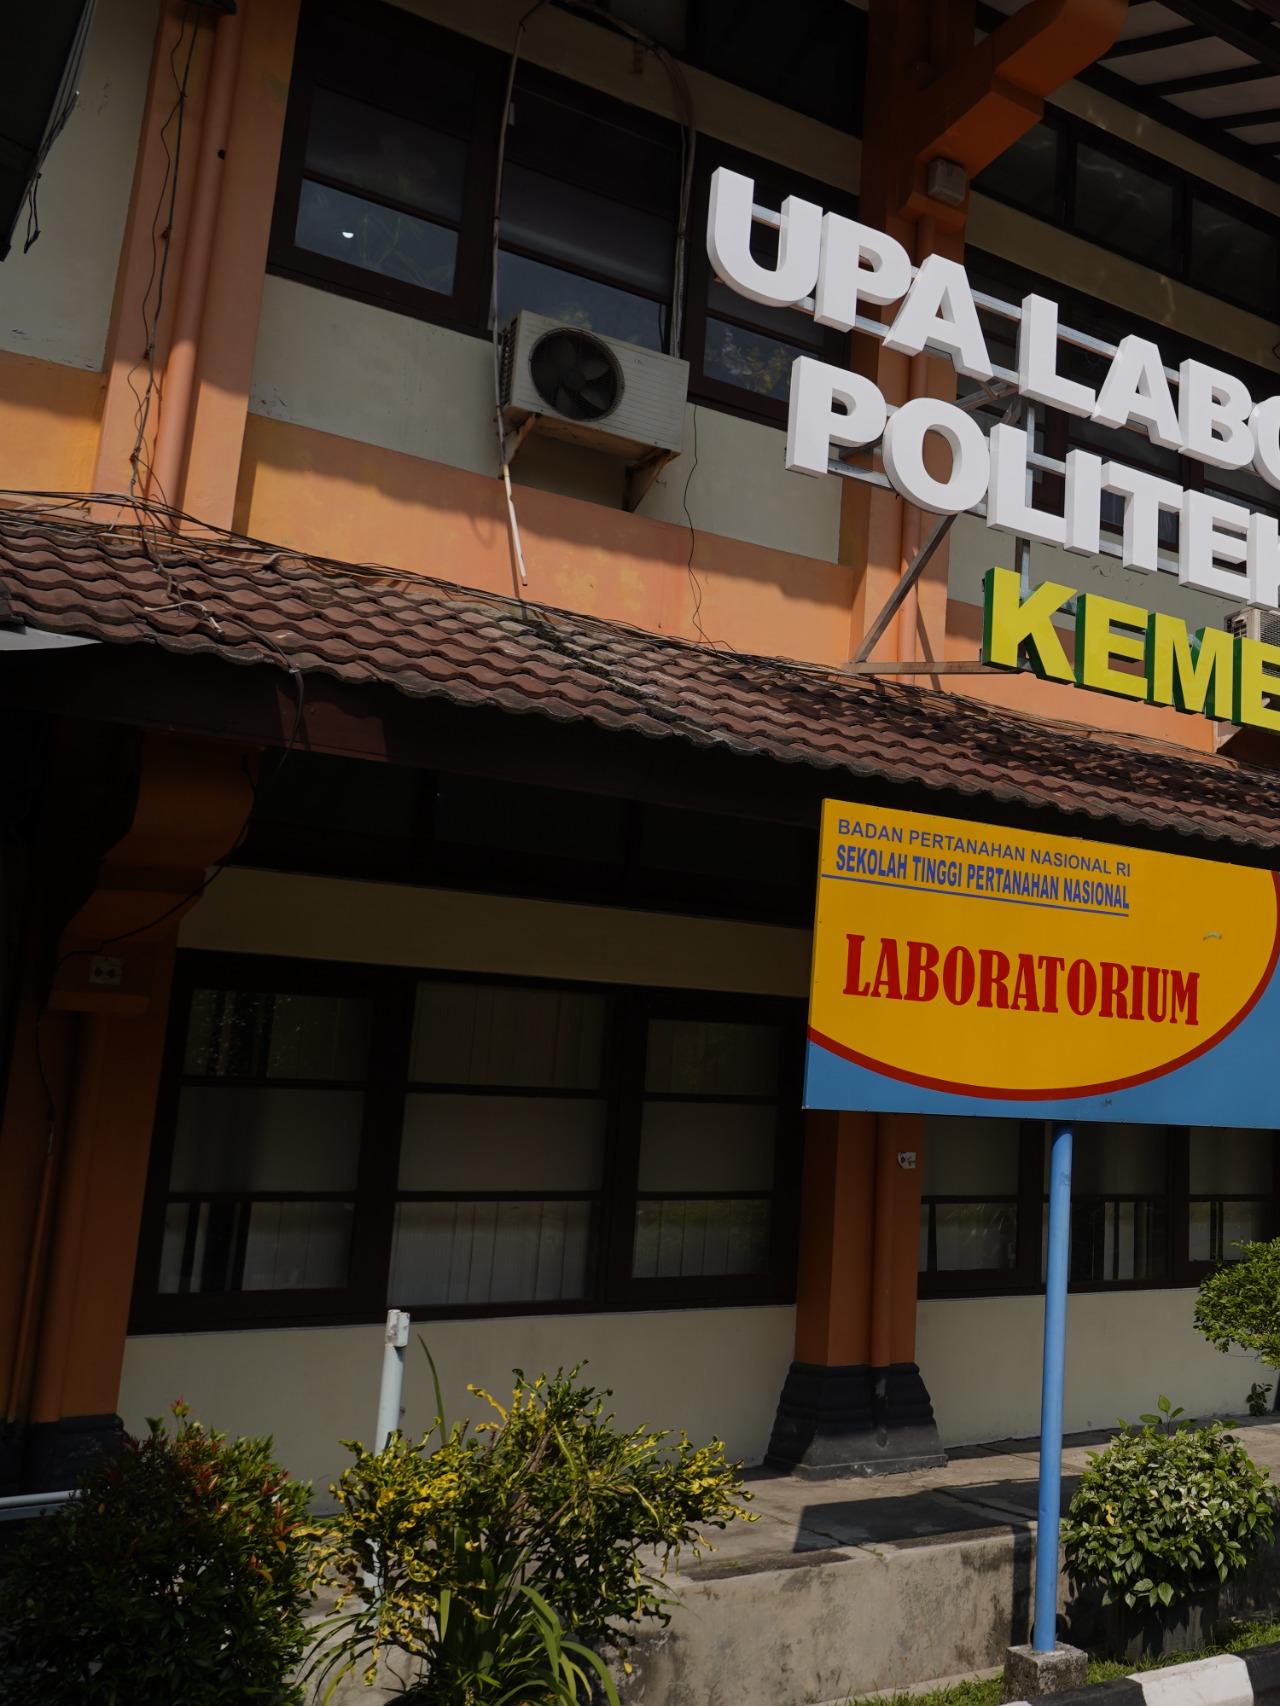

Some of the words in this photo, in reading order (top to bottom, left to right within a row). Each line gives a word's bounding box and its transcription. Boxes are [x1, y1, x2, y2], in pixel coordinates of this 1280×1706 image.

[706, 166, 994, 382] UPA
[835, 844, 907, 880] SEKOLAH
[912, 856, 963, 888] TINGGI
[966, 863, 1060, 901] PERTANAHAN
[1063, 879, 1130, 910] NASIONAL
[838, 818, 903, 844] BADAN
[908, 829, 1026, 863] PERTANAHAN
[1031, 848, 1112, 875] NASIONAL
[1116, 861, 1131, 877] RI
[843, 933, 1200, 1026] LABORATORIUM
